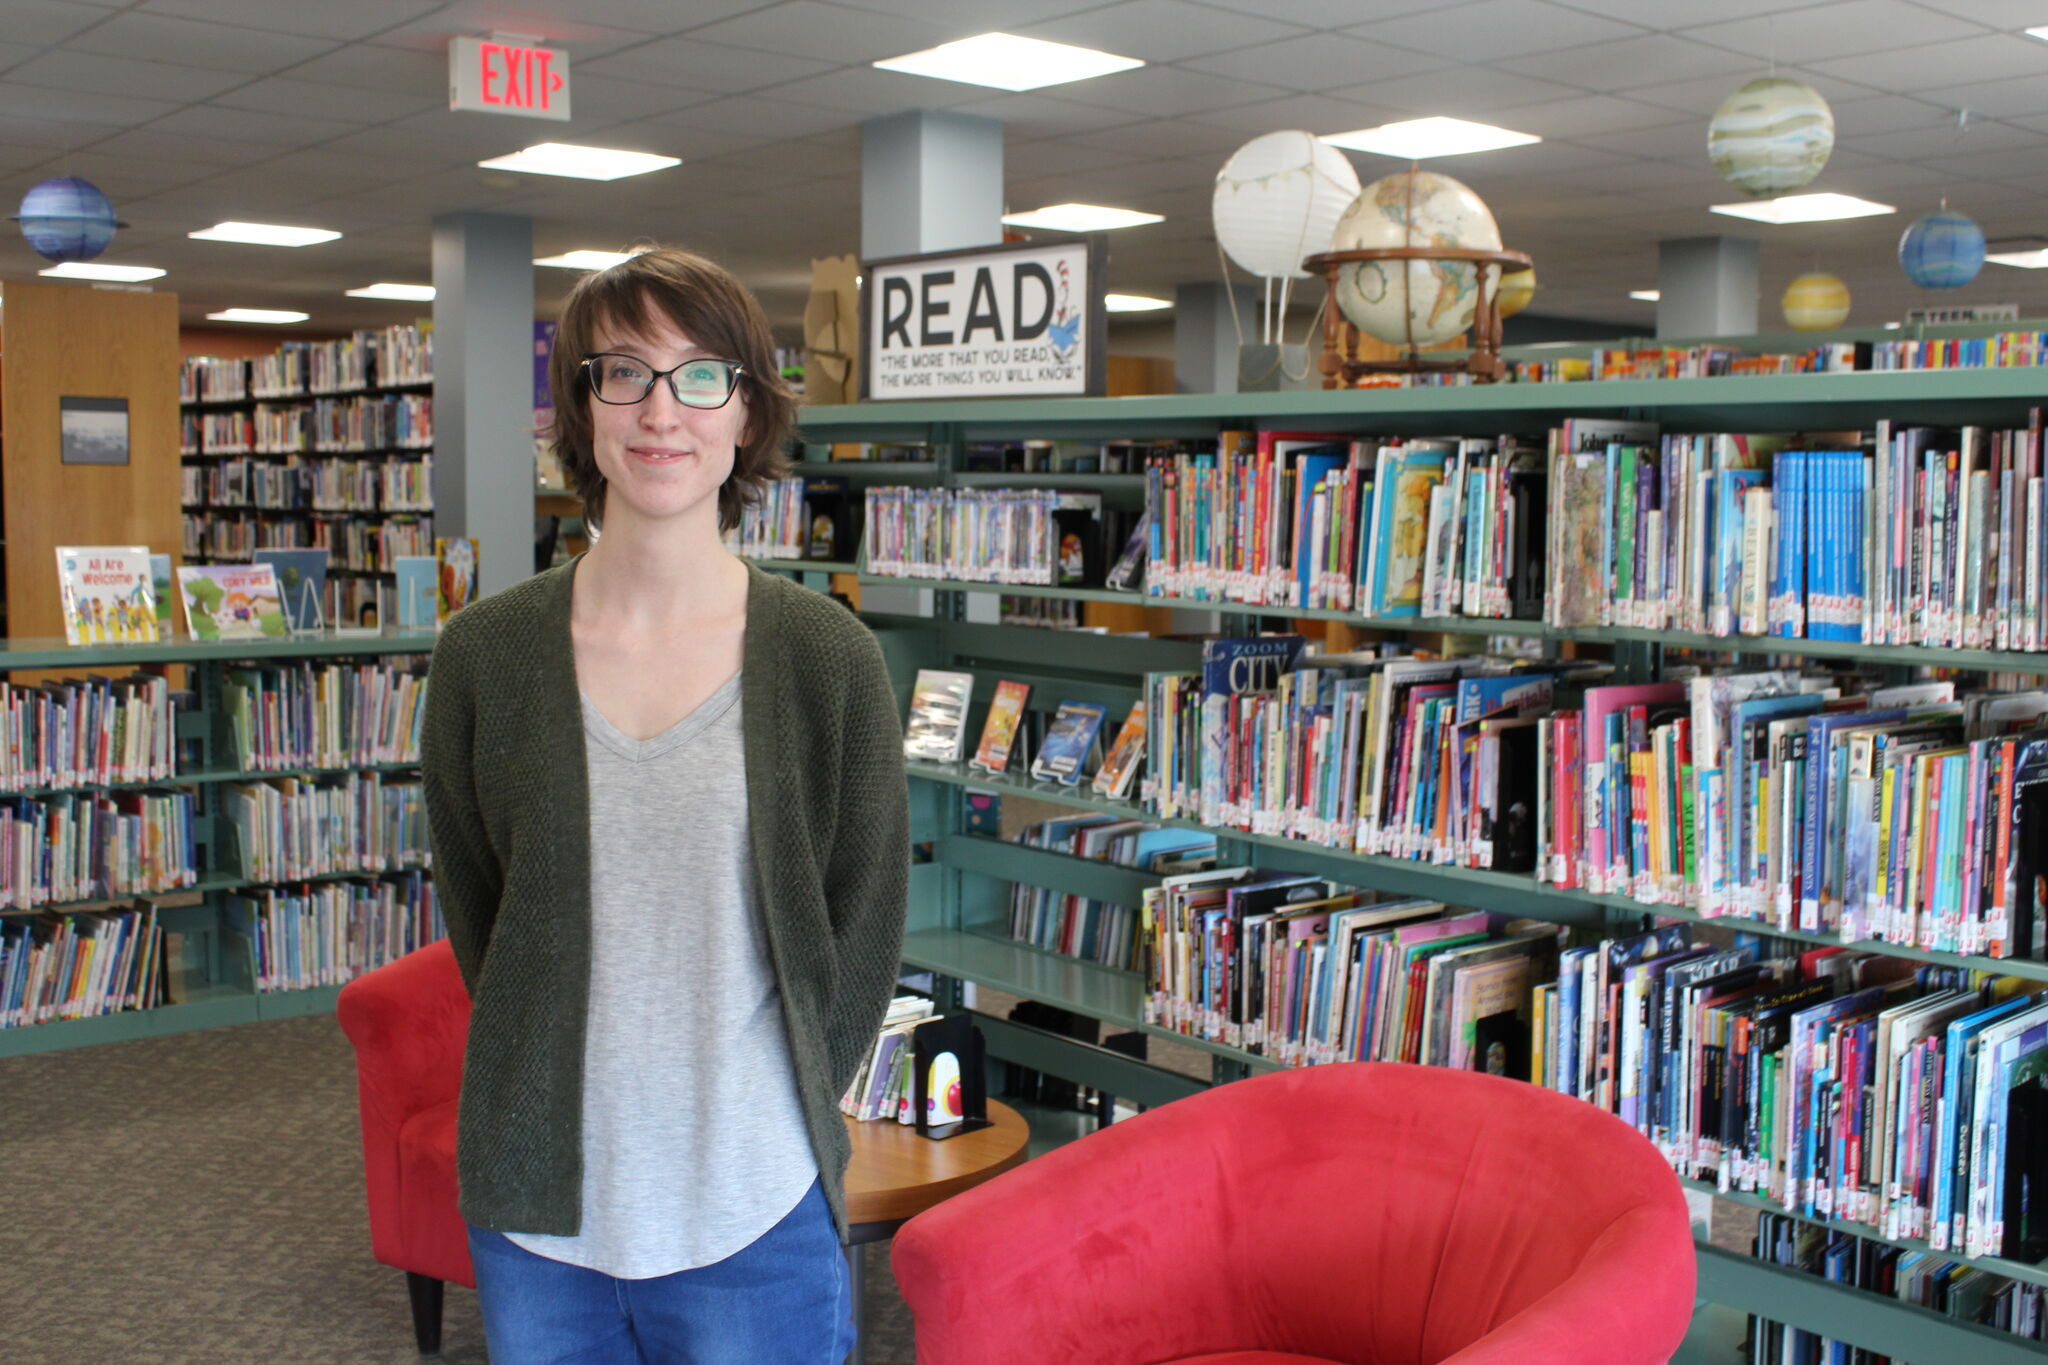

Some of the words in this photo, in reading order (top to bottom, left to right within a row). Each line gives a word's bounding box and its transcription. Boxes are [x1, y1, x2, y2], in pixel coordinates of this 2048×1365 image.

[480, 42, 554, 111] EXIT
[882, 261, 1055, 349] READ
[880, 354, 907, 370] "THE
[912, 353, 943, 368] MORE
[950, 351, 979, 367] THAT
[984, 349, 1010, 365] YOU
[1014, 347, 1050, 364] READ,
[880, 374, 899, 388] THE
[903, 373, 932, 387] MORE
[937, 369, 974, 385] THINGS
[978, 367, 1001, 383] YOU
[1006, 366, 1033, 382] WILL
[89, 559, 100, 571] All
[104, 559, 124, 571] Are
[1746, 527, 1757, 591] BEAUTY
[82, 573, 133, 587] Welcome
[1232, 642, 1288, 656] ZOOM
[1229, 654, 1289, 695] CITY
[1808, 764, 1818, 792] GREAT
[1807, 795, 1817, 828] SCIENCE
[1685, 803, 1694, 856] SCIENCE
[1805, 831, 1816, 891] EXPERIMENTS
[1664, 986, 1673, 1016] SOLAR
[1663, 1018, 1672, 1054] SYSTEM
